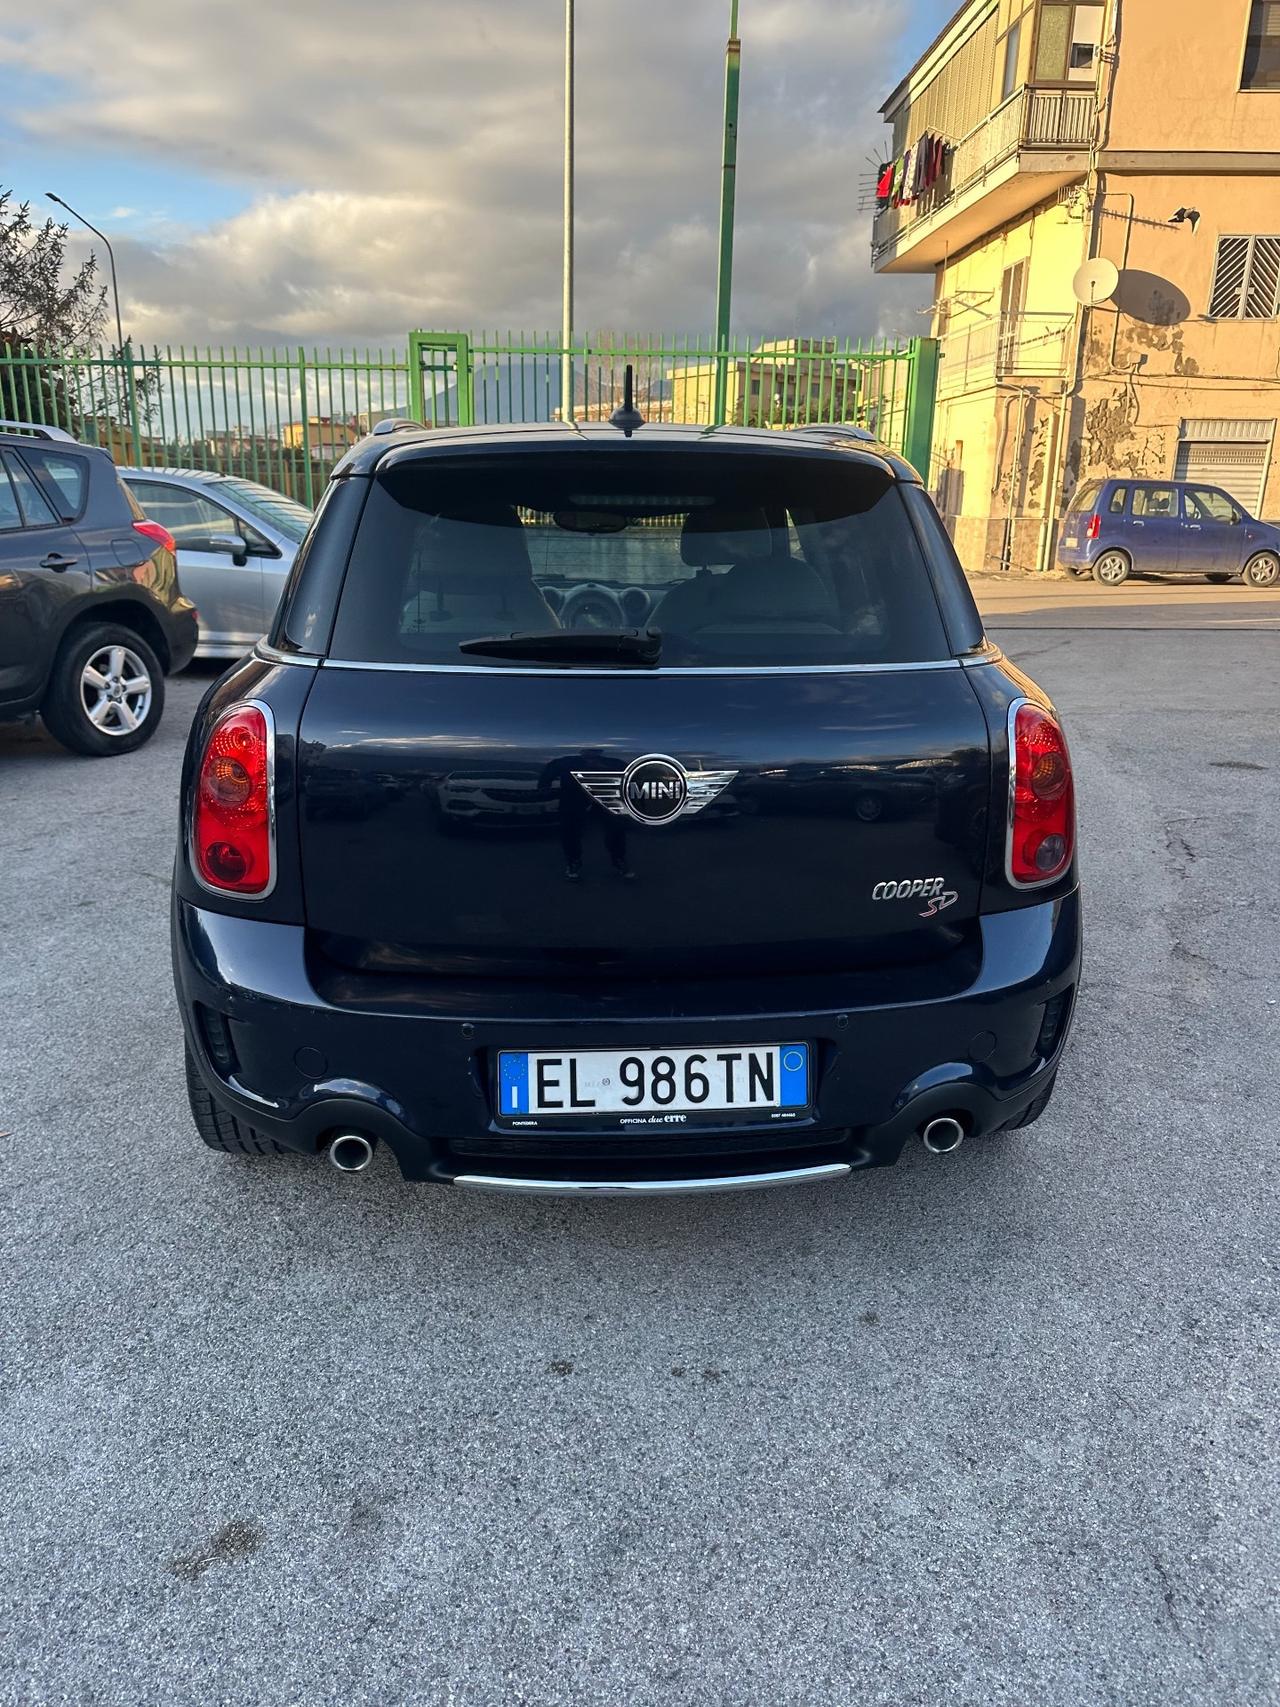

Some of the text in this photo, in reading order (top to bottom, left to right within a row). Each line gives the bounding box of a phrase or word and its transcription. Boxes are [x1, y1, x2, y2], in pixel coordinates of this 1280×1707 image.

[628, 781, 681, 799] MINI
[872, 877, 945, 900] COOPER
[919, 891, 959, 917] SD
[536, 1052, 774, 1108] EL 986TN
[664, 1114, 687, 1123] erre
